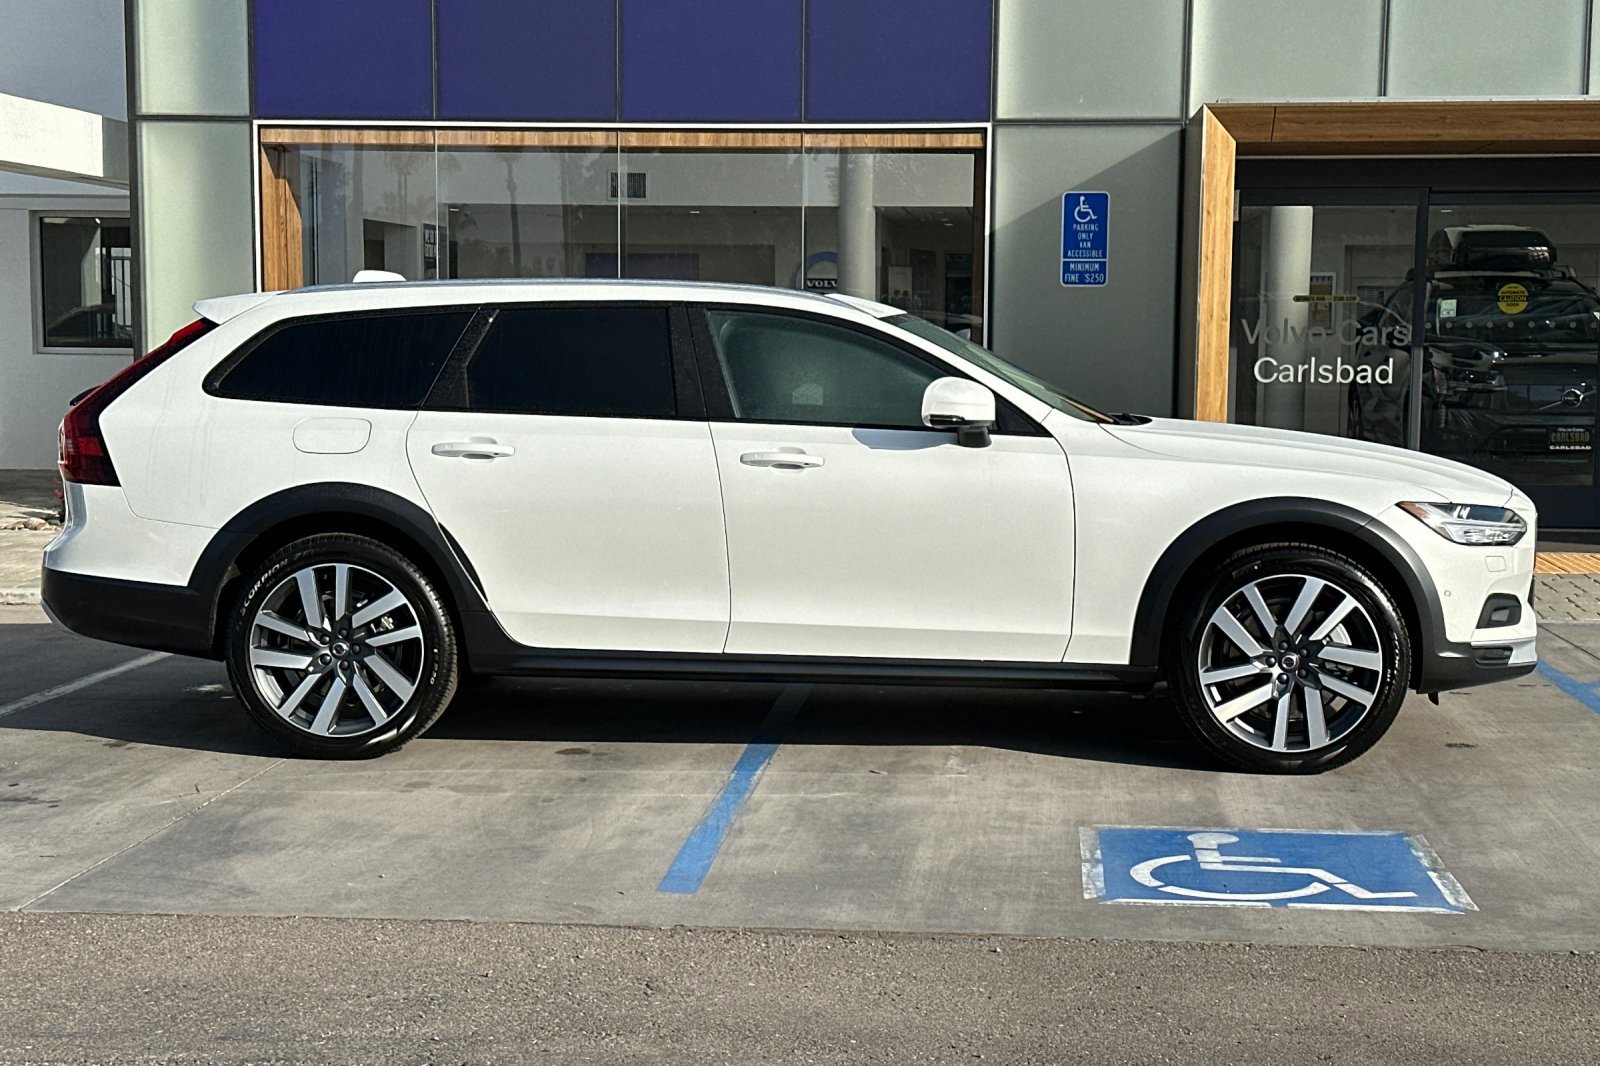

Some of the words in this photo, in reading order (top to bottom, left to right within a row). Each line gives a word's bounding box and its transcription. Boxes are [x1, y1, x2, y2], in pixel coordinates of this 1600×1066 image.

[1072, 223, 1099, 232] PARKING
[1077, 232, 1094, 240] ONLY
[1079, 241, 1091, 249] VAN
[1067, 249, 1103, 258] ACCESSIBLE
[1069, 262, 1100, 272] MINIMUM
[1064, 273, 1080, 283] FINE
[1084, 273, 1105, 283] $250
[807, 280, 838, 288] VOLV
[1240, 317, 1327, 346] Volvo
[1338, 319, 1409, 347] Cars
[1253, 356, 1394, 385] Carlsbad
[240, 558, 288, 617] SCORPION
